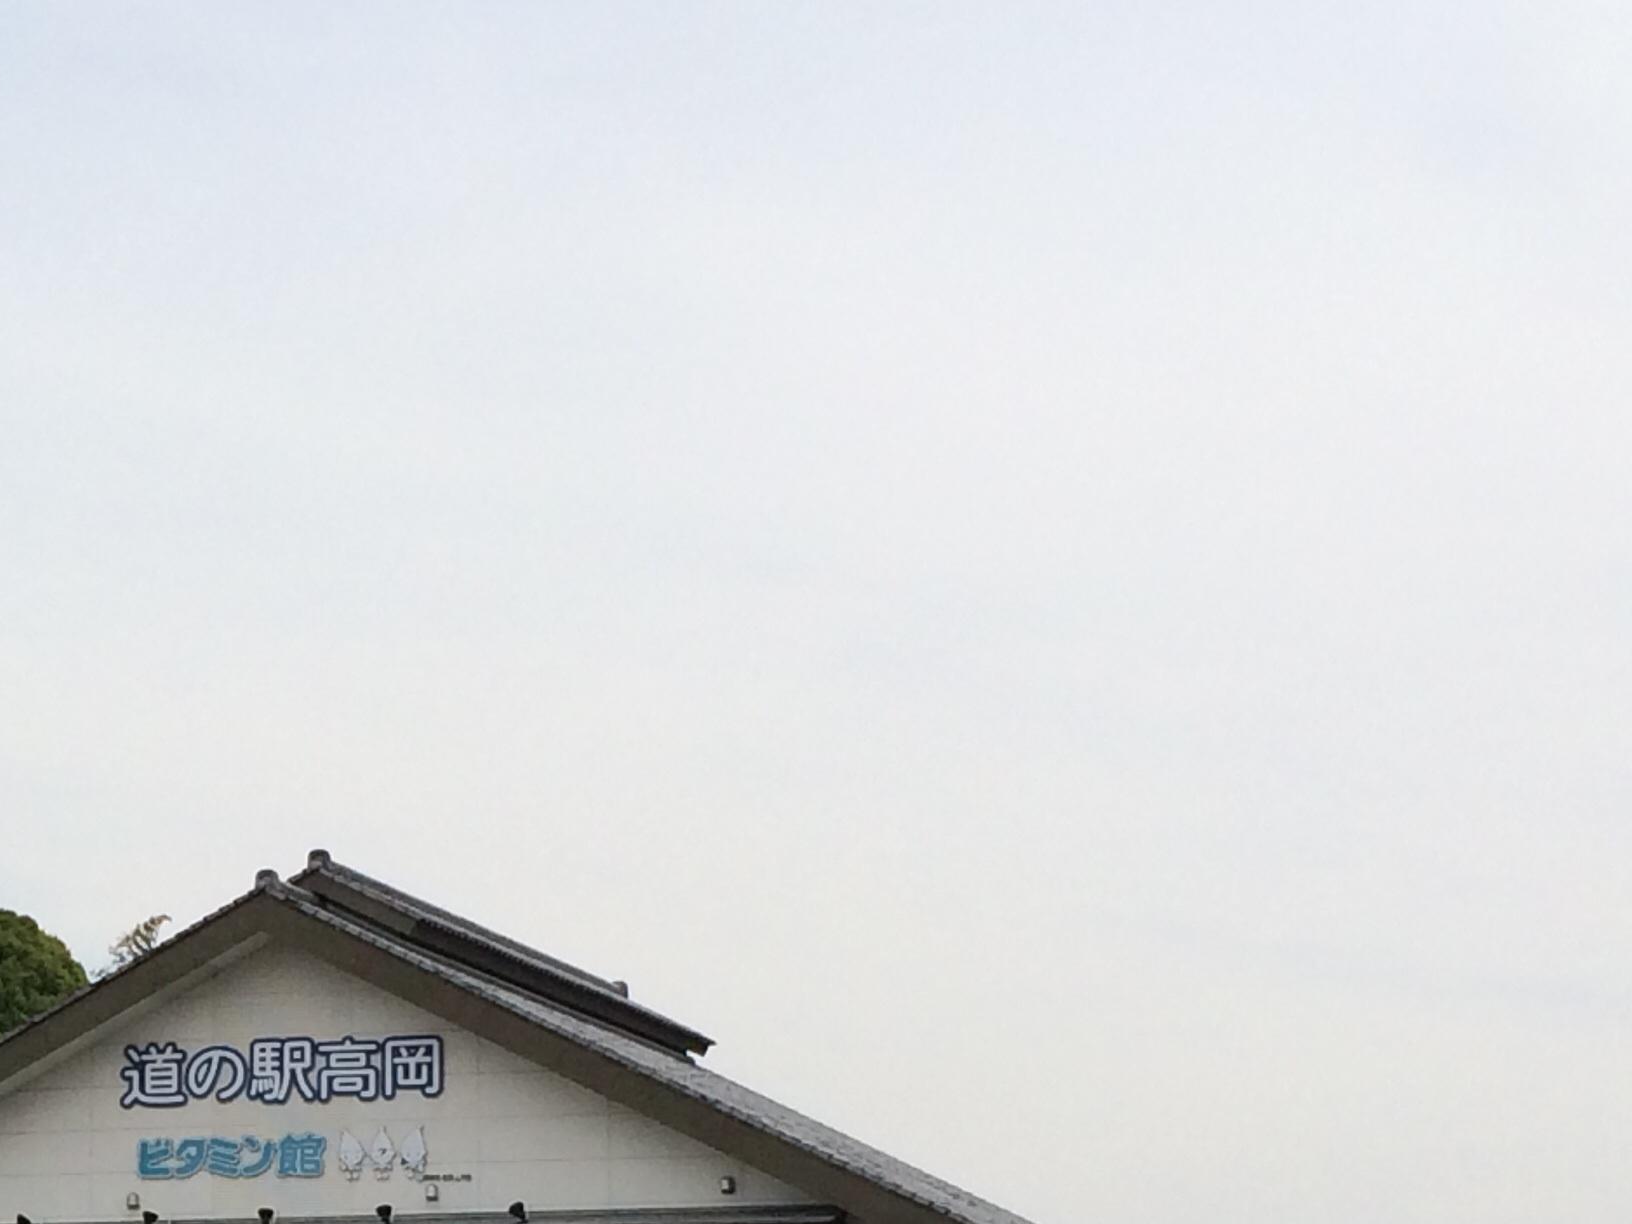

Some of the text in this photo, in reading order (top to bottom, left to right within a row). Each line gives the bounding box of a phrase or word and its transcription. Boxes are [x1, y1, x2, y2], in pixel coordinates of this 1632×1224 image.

[120, 1034, 445, 1108] 道の駅高岡
[137, 1131, 327, 1180] ビタミン館
